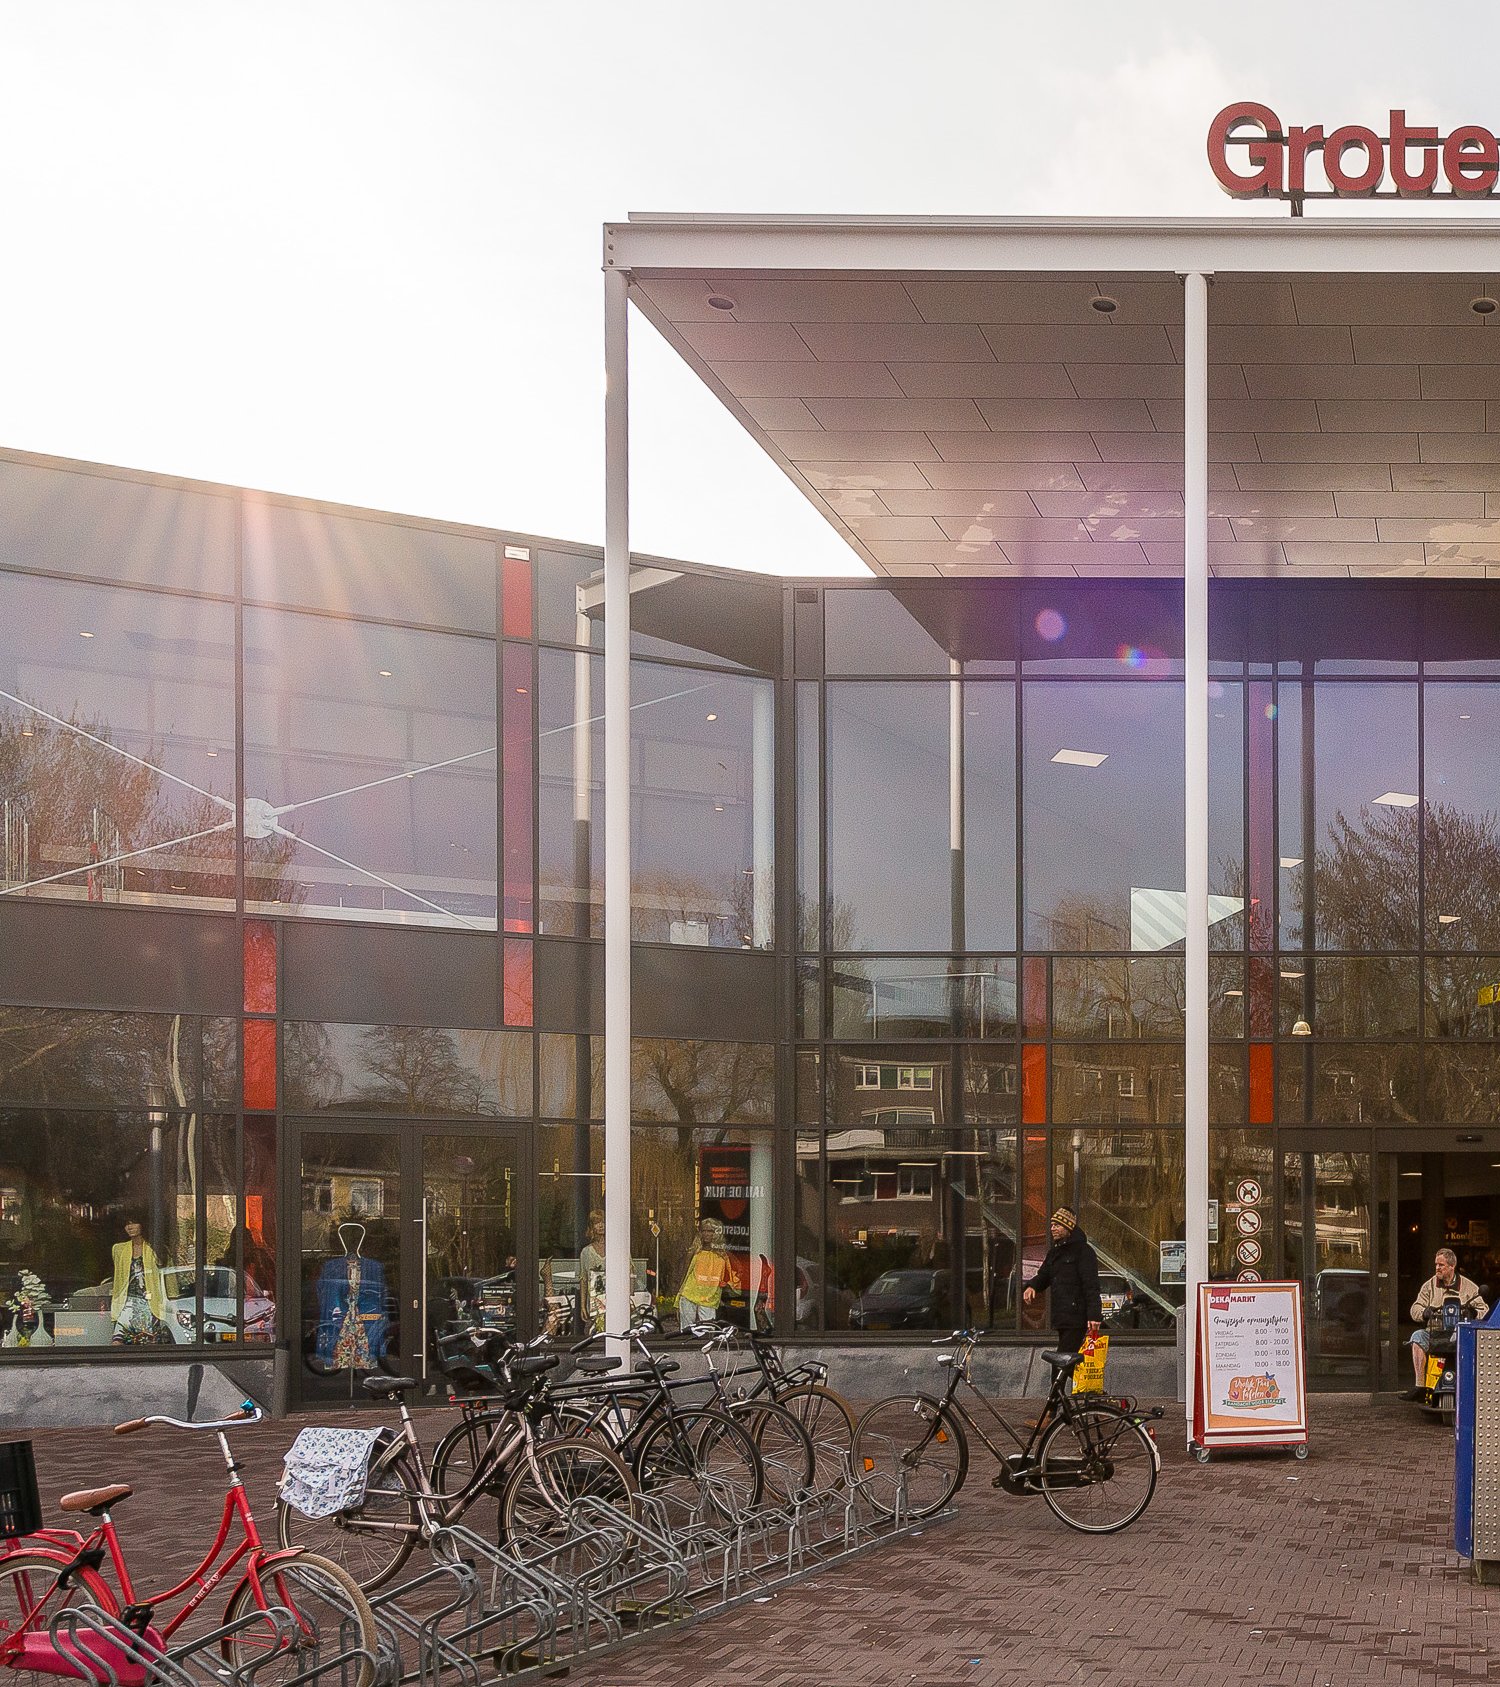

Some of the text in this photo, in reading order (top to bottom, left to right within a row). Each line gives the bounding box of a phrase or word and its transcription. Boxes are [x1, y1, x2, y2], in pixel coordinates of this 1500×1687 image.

[1206, 101, 1500, 198] Grote
[1210, 1295, 1256, 1304] DEKAMARKT
[1274, 1327, 1289, 1335] 19.00
